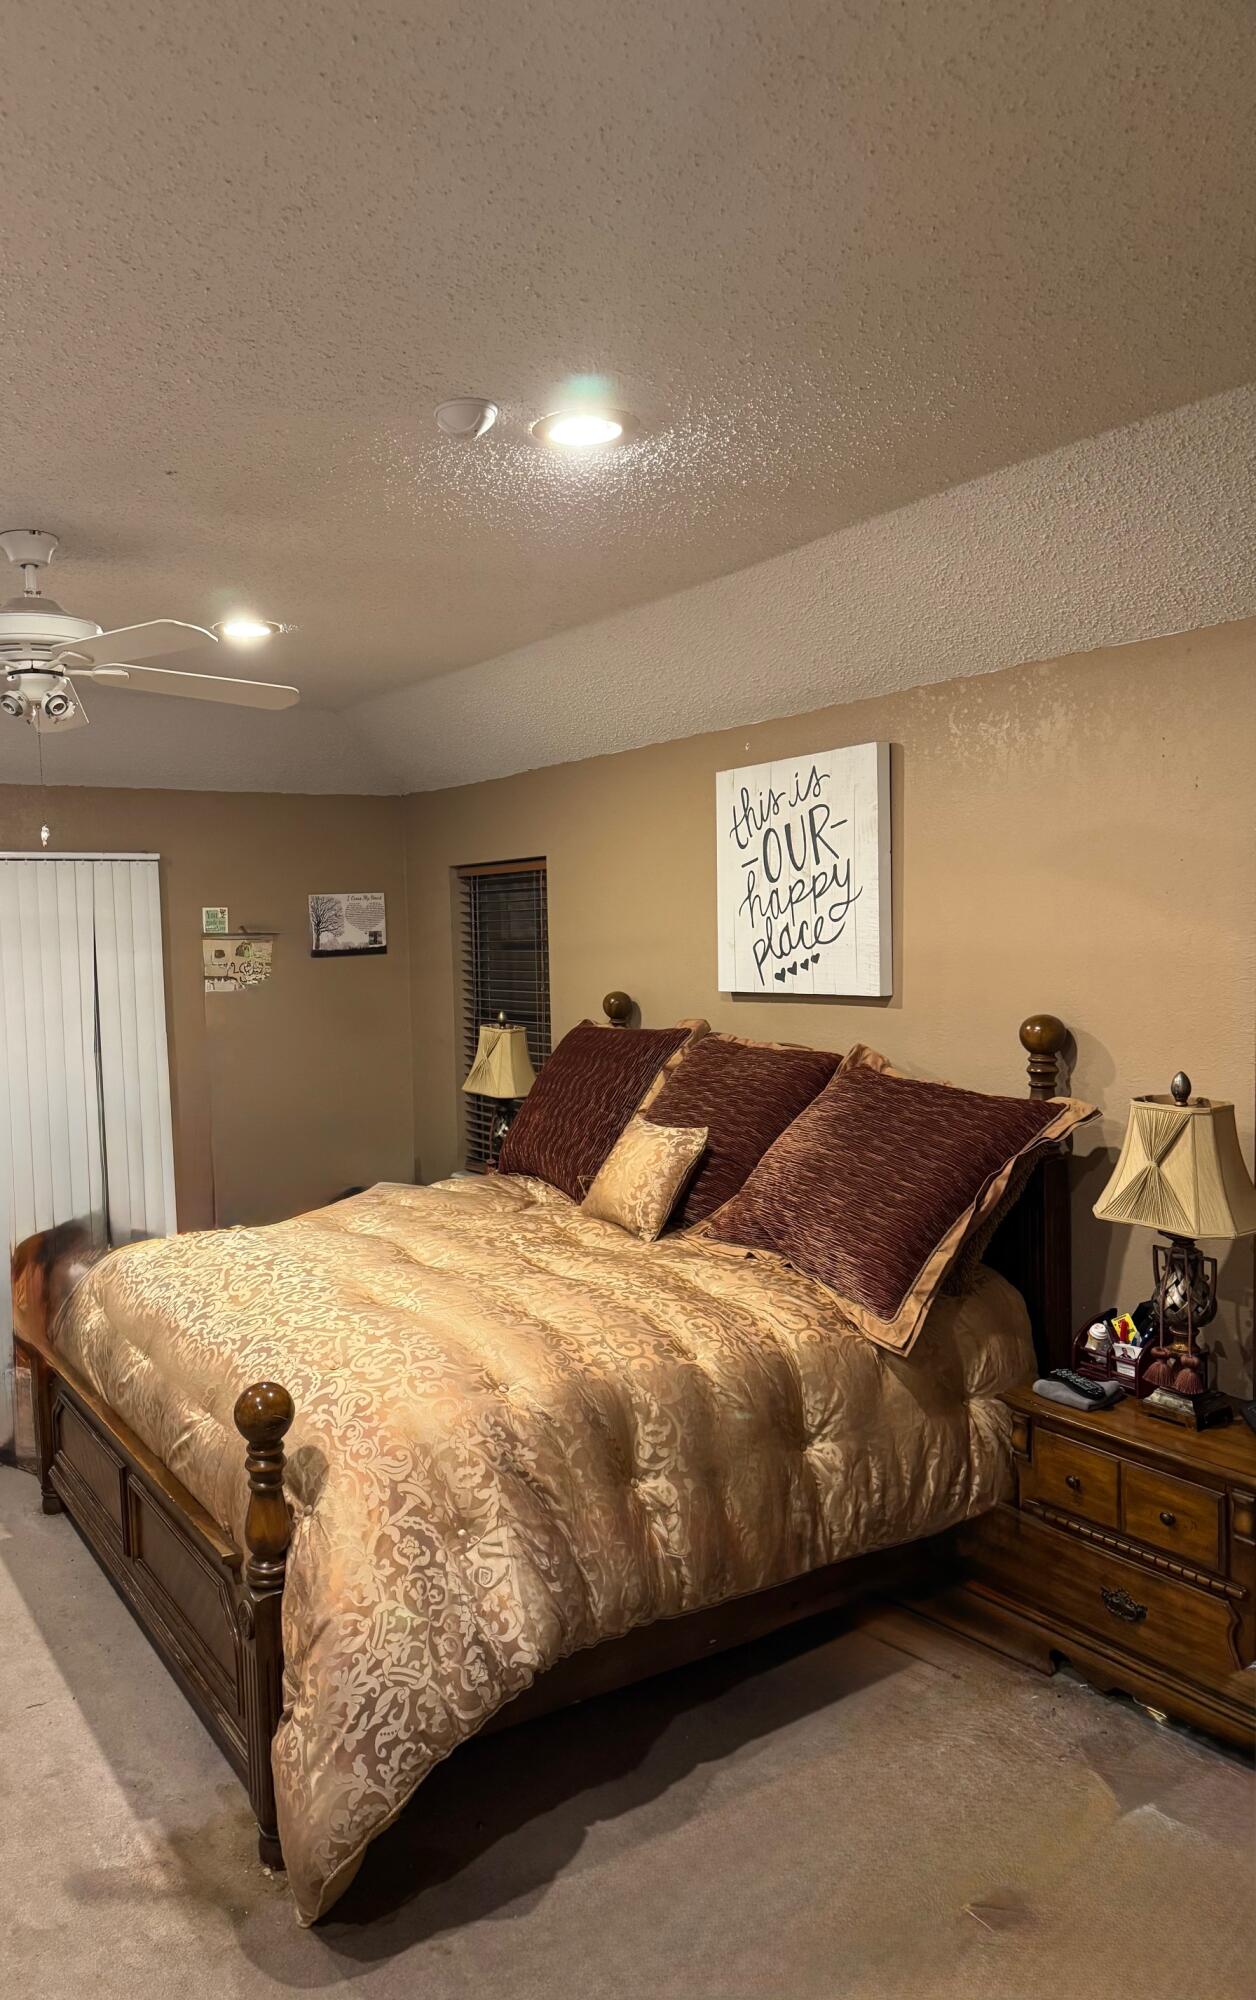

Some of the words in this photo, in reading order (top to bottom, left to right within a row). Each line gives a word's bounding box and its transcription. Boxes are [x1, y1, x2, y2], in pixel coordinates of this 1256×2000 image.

[729, 787, 786, 850] this
[788, 764, 831, 808] is
[738, 858, 863, 929] happy
[752, 915, 846, 987] place
